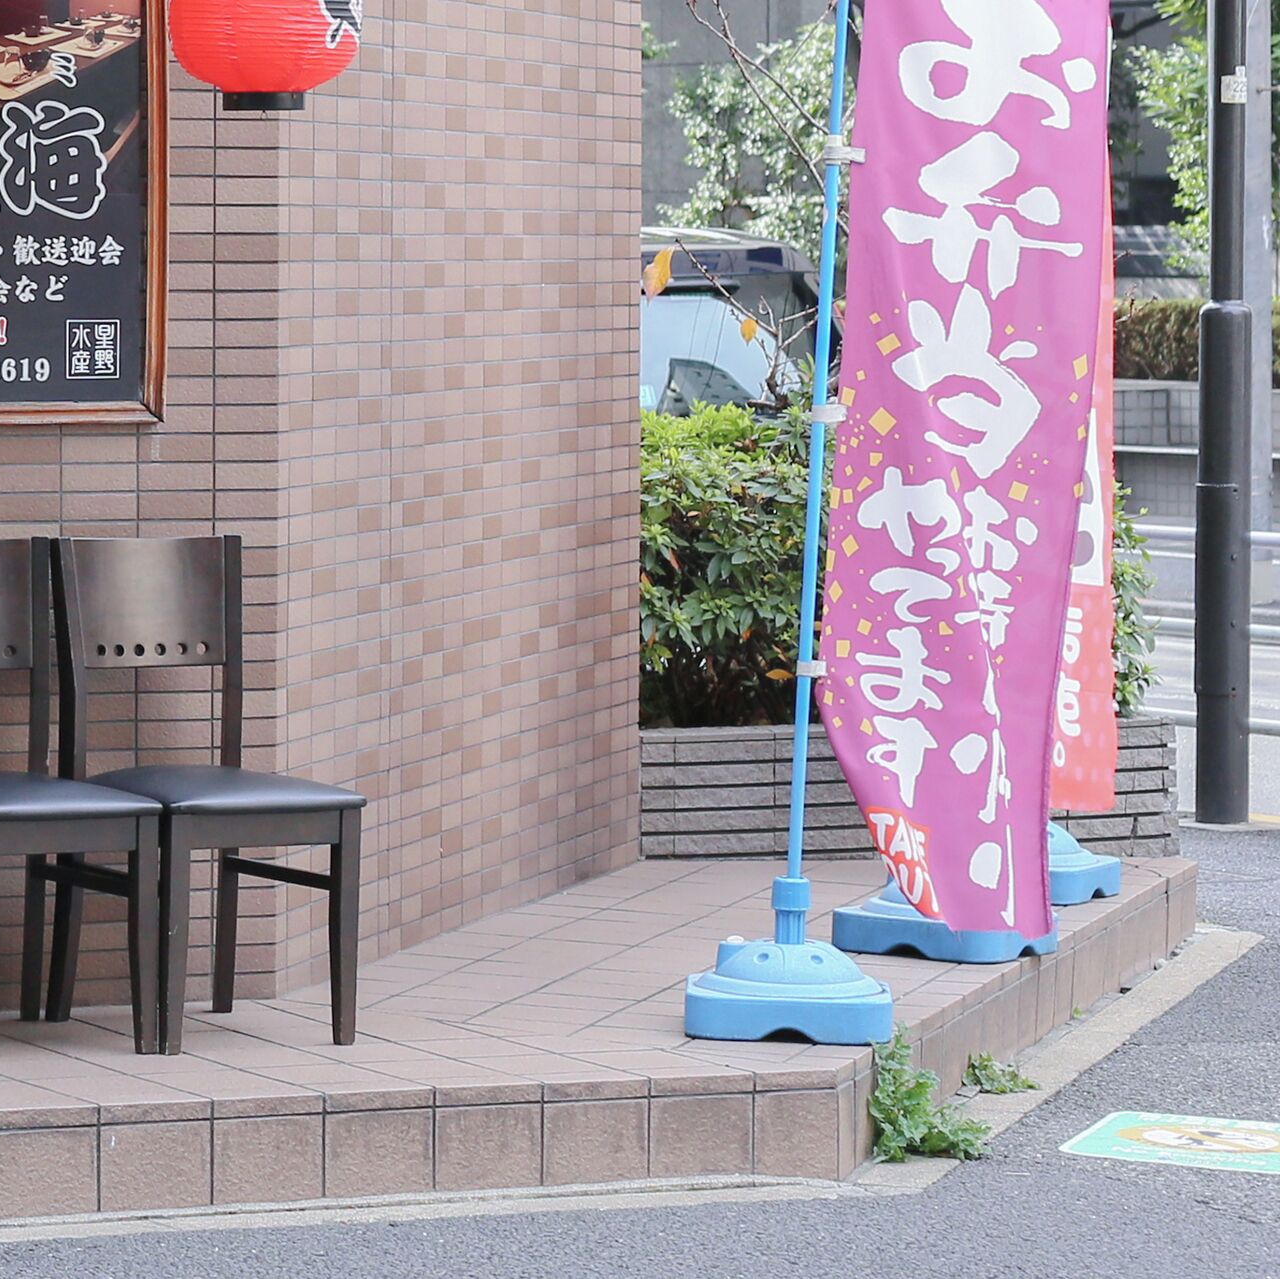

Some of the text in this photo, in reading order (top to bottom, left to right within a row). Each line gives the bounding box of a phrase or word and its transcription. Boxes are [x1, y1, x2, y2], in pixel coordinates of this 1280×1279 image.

[854, 465, 962, 809] やってます
